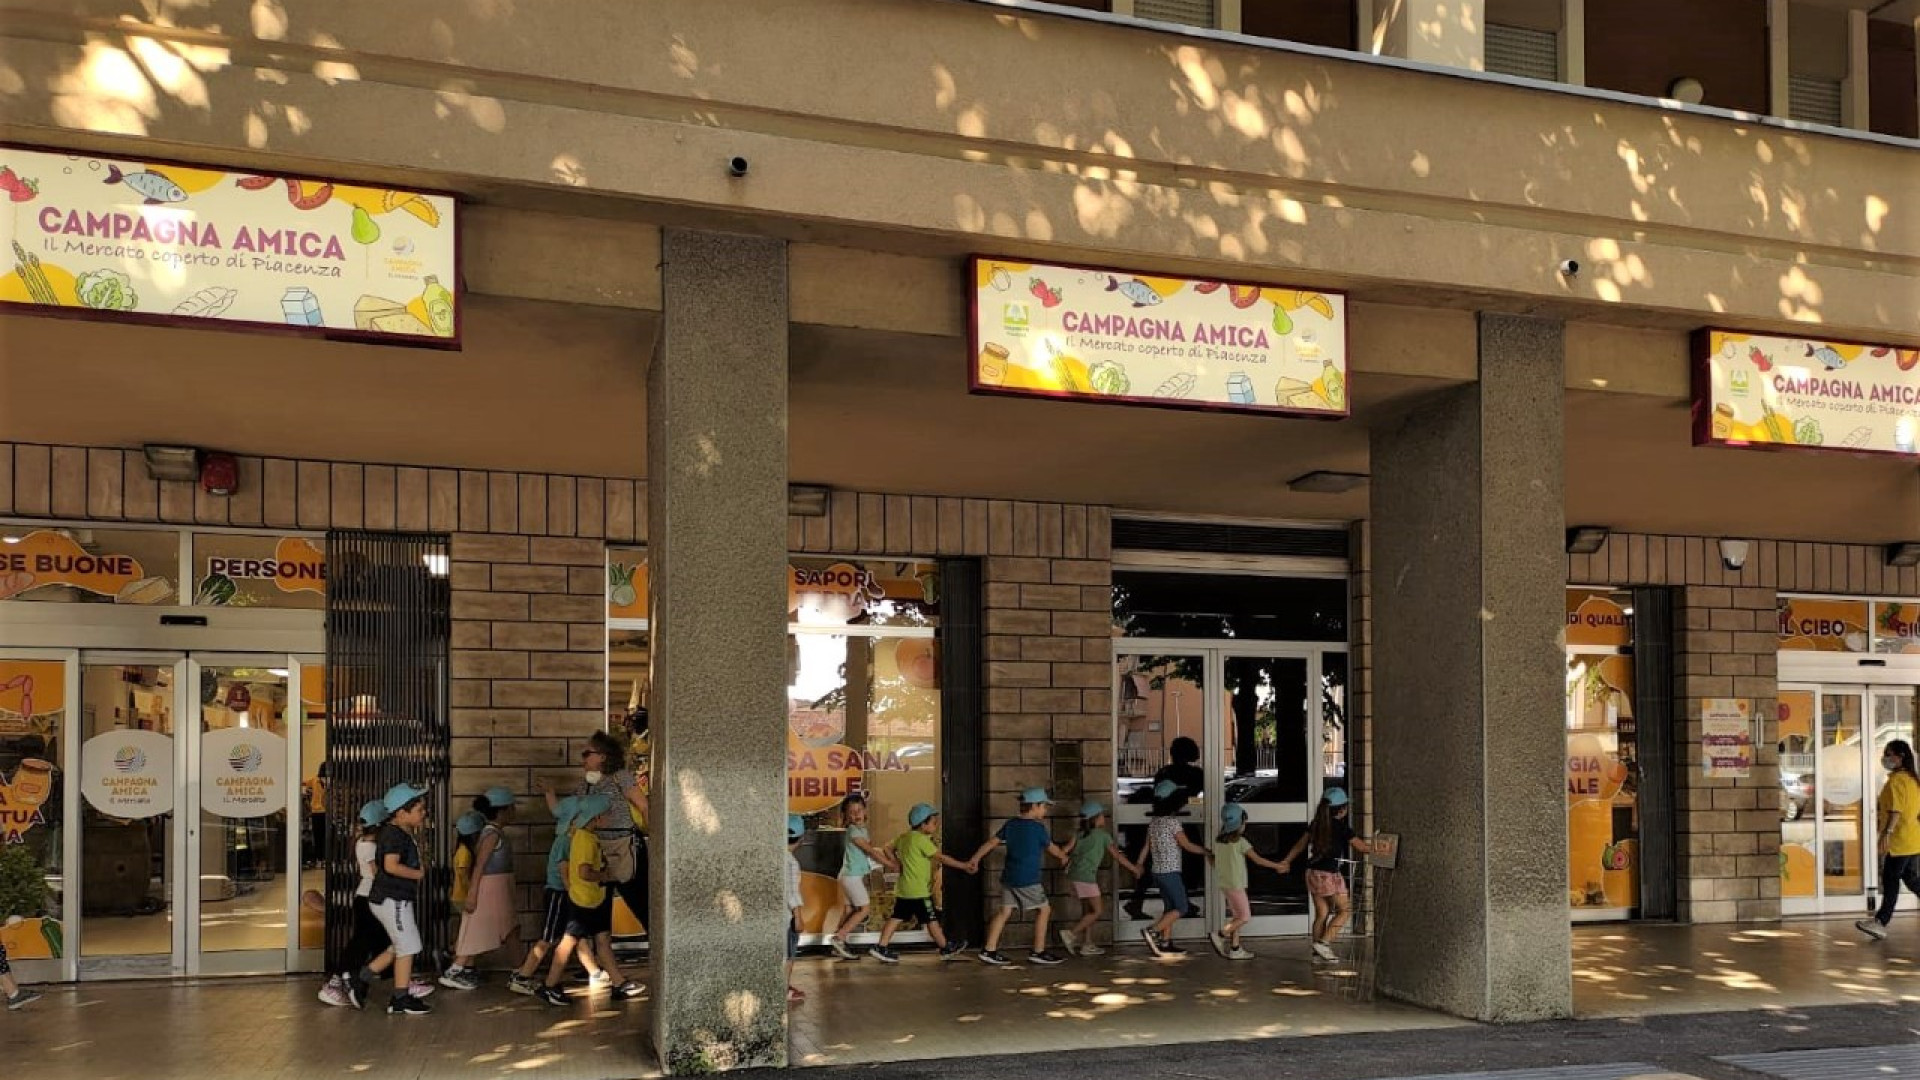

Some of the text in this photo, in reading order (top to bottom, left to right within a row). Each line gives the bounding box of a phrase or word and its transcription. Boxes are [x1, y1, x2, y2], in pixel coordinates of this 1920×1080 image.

[38, 206, 346, 261] CAMPAGNA AMICA
[64, 239, 145, 259] Mercato
[151, 250, 220, 269] coperto
[226, 252, 247, 268] di
[252, 255, 342, 277] Piacenza
[1062, 311, 1270, 349] CAMPAGNA AMICA
[1080, 338, 1135, 353] Mercato
[1138, 342, 1184, 357] coperto
[1188, 344, 1202, 358] di
[1206, 346, 1267, 364] Piacenza
[1773, 374, 1864, 400] CAMPAGNA
[35, 554, 133, 575] BUONE
[1801, 619, 1845, 636] CIBO
[827, 751, 910, 772] SANA,
[102, 777, 158, 787] CAMPAGNA
[112, 787, 148, 796] AMICA
[216, 777, 274, 787] CAMPAGNA
[227, 787, 265, 796] AMICA
